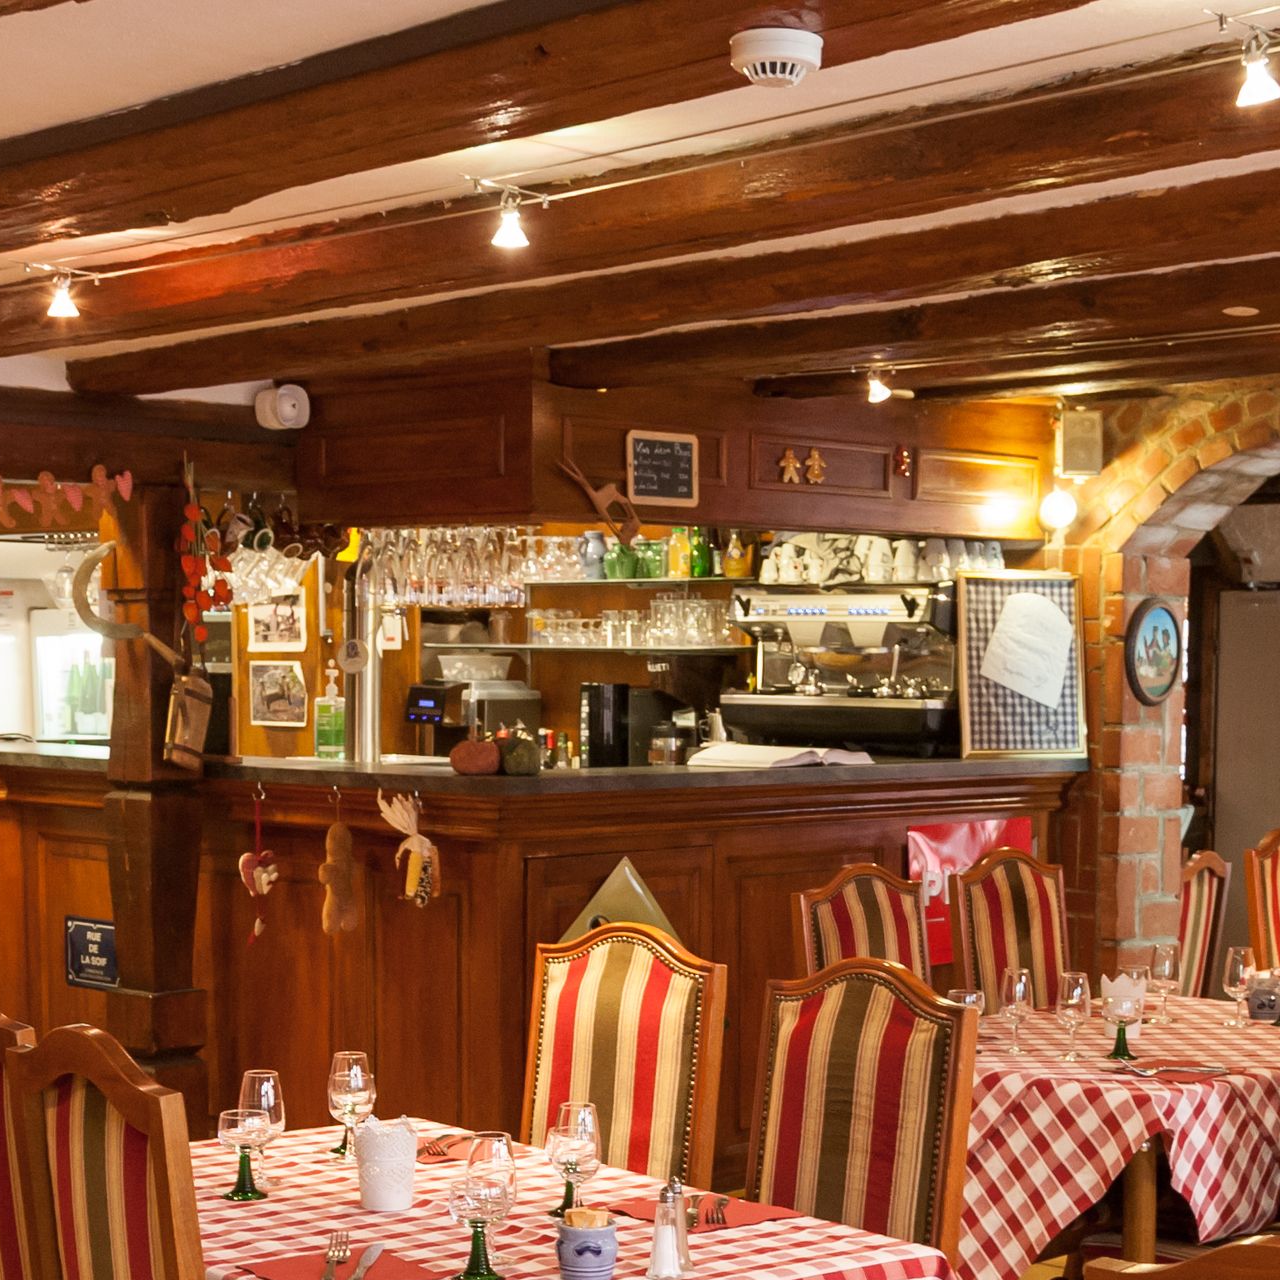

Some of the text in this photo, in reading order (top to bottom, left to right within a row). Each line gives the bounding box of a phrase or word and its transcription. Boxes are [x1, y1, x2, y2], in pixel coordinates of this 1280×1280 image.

[86, 931, 102, 942] RUE
[88, 944, 99, 954] DE
[80, 955, 108, 966] LA SOIF
